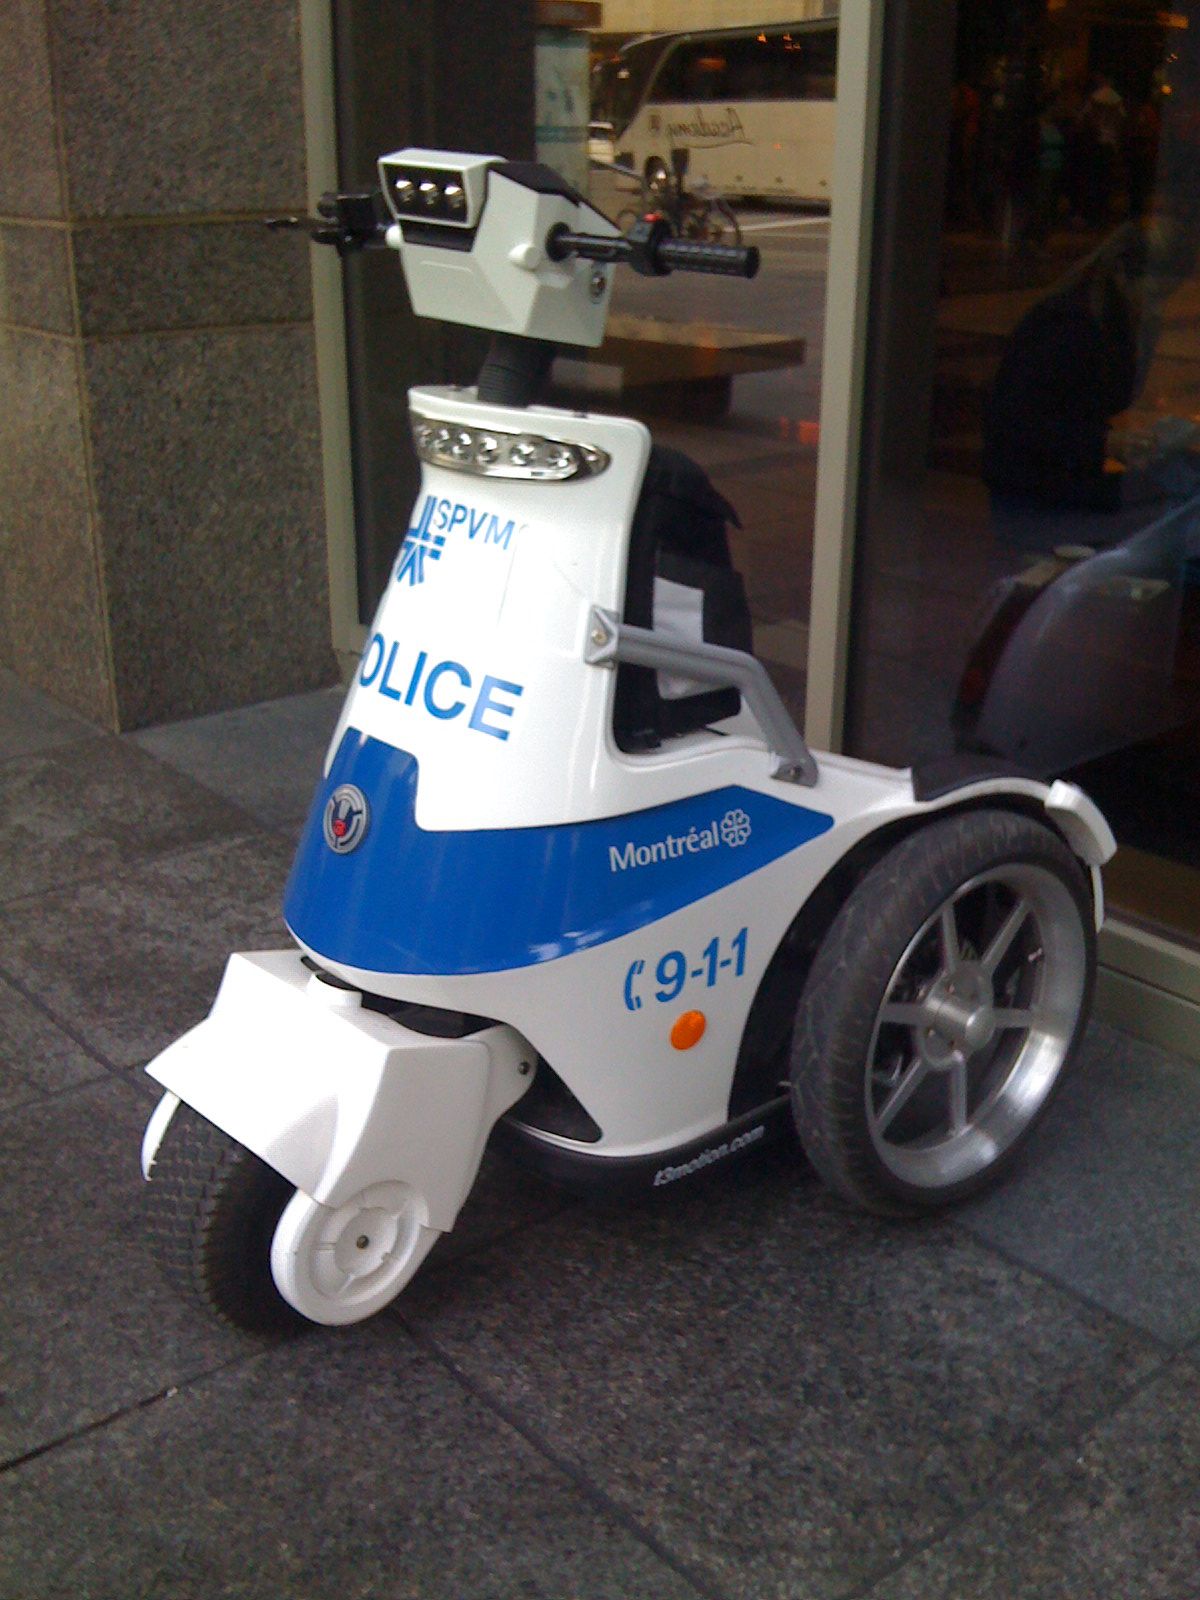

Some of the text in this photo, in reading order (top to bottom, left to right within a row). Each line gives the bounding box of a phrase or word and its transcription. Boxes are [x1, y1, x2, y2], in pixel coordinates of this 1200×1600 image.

[437, 499, 516, 550] SPVM
[359, 632, 524, 742] OLICE
[609, 821, 719, 872] Montréal
[655, 926, 749, 1003] 9-1-1
